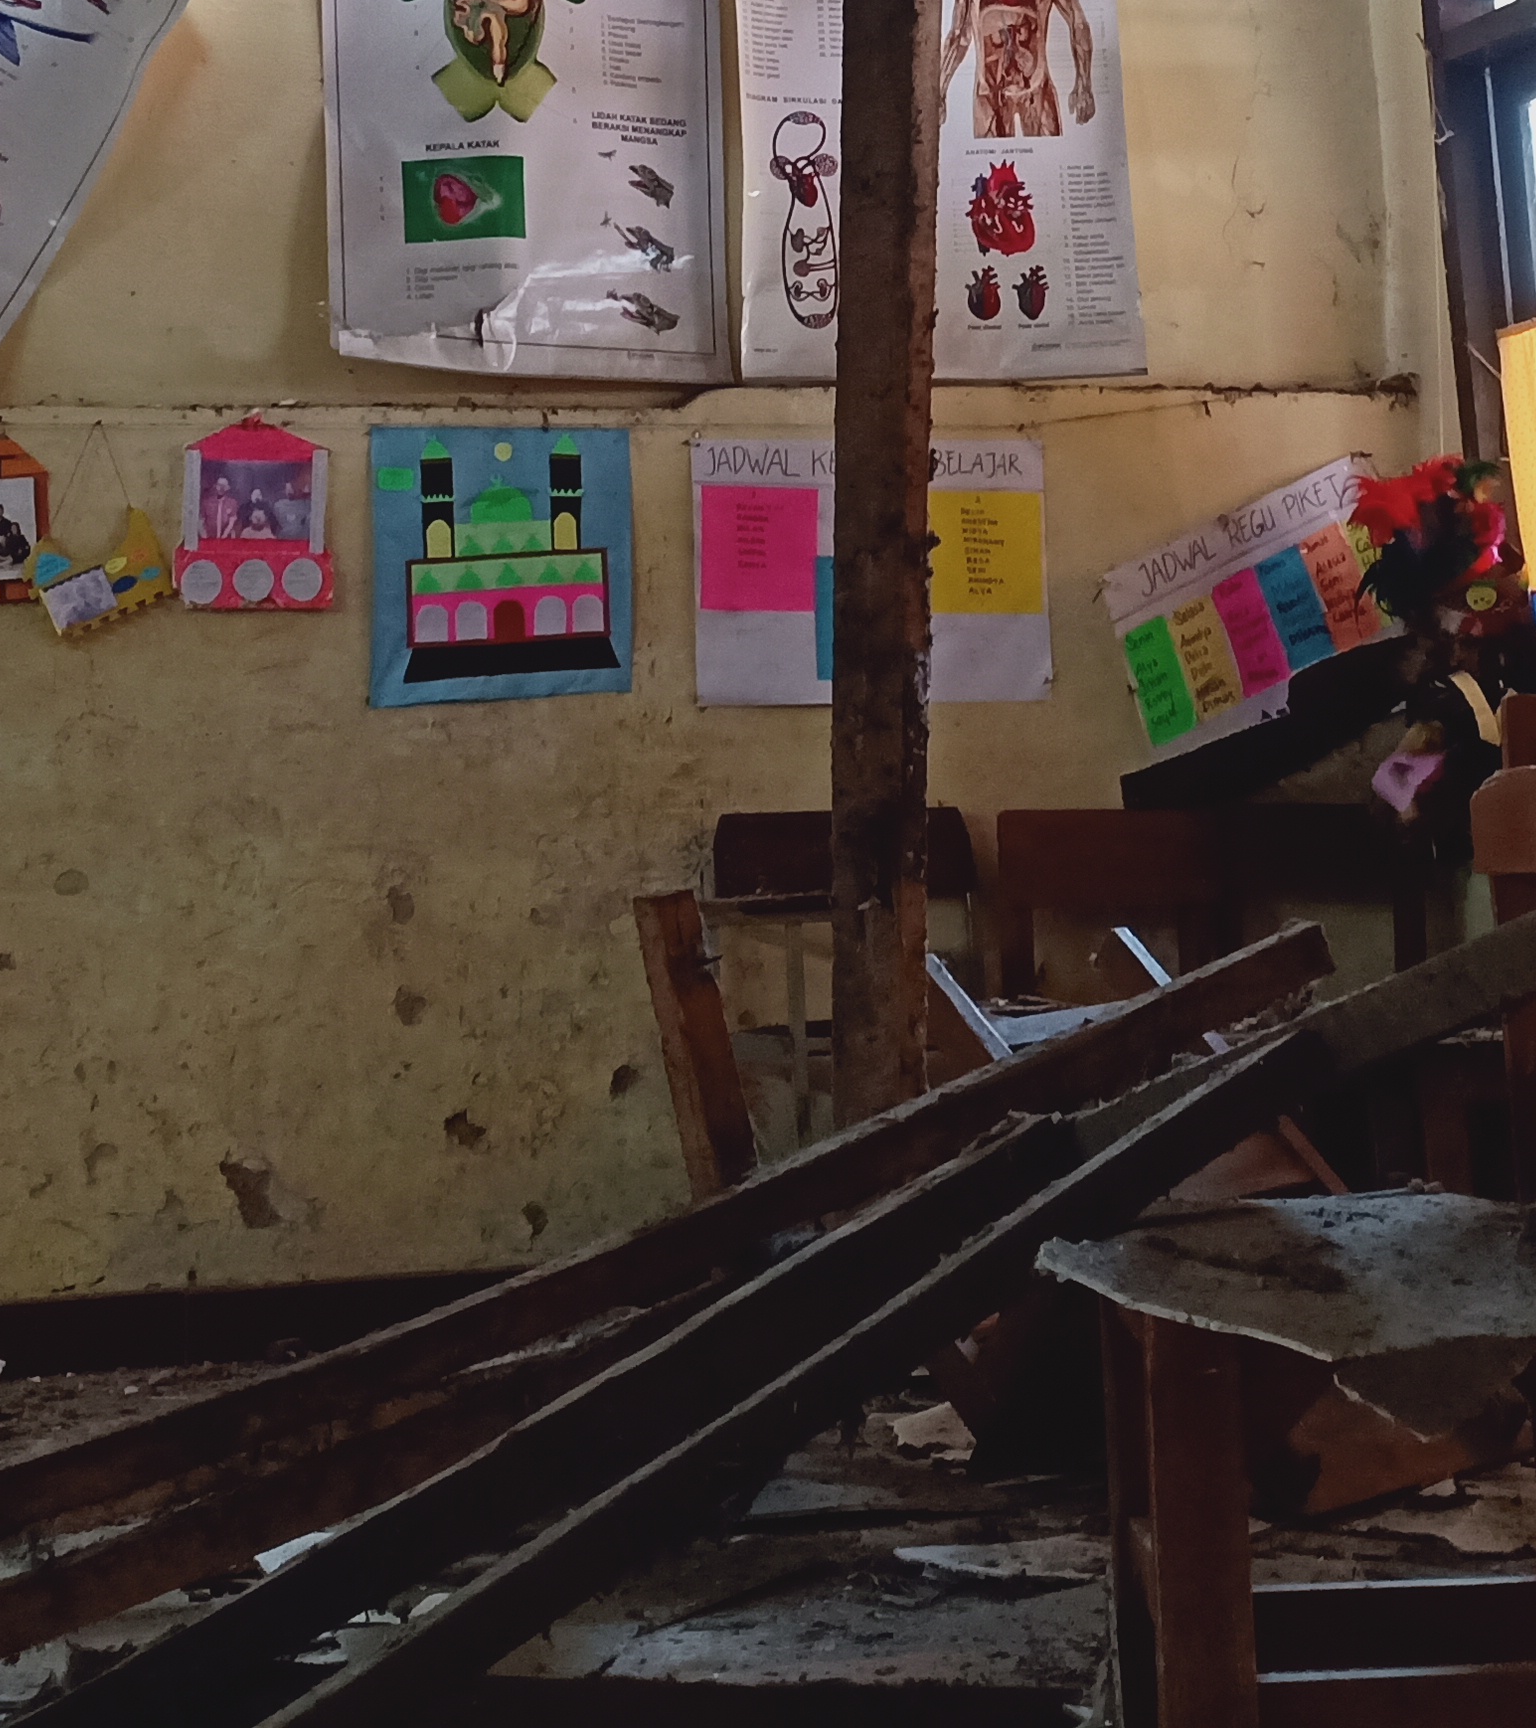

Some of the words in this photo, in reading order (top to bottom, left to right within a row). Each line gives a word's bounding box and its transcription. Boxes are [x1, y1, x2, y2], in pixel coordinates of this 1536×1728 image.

[425, 142, 464, 151] KEPALA
[468, 140, 499, 149] KATAK
[706, 445, 801, 478] JADWAL
[1138, 536, 1216, 597] JADWAL
[1226, 505, 1276, 548] REGU
